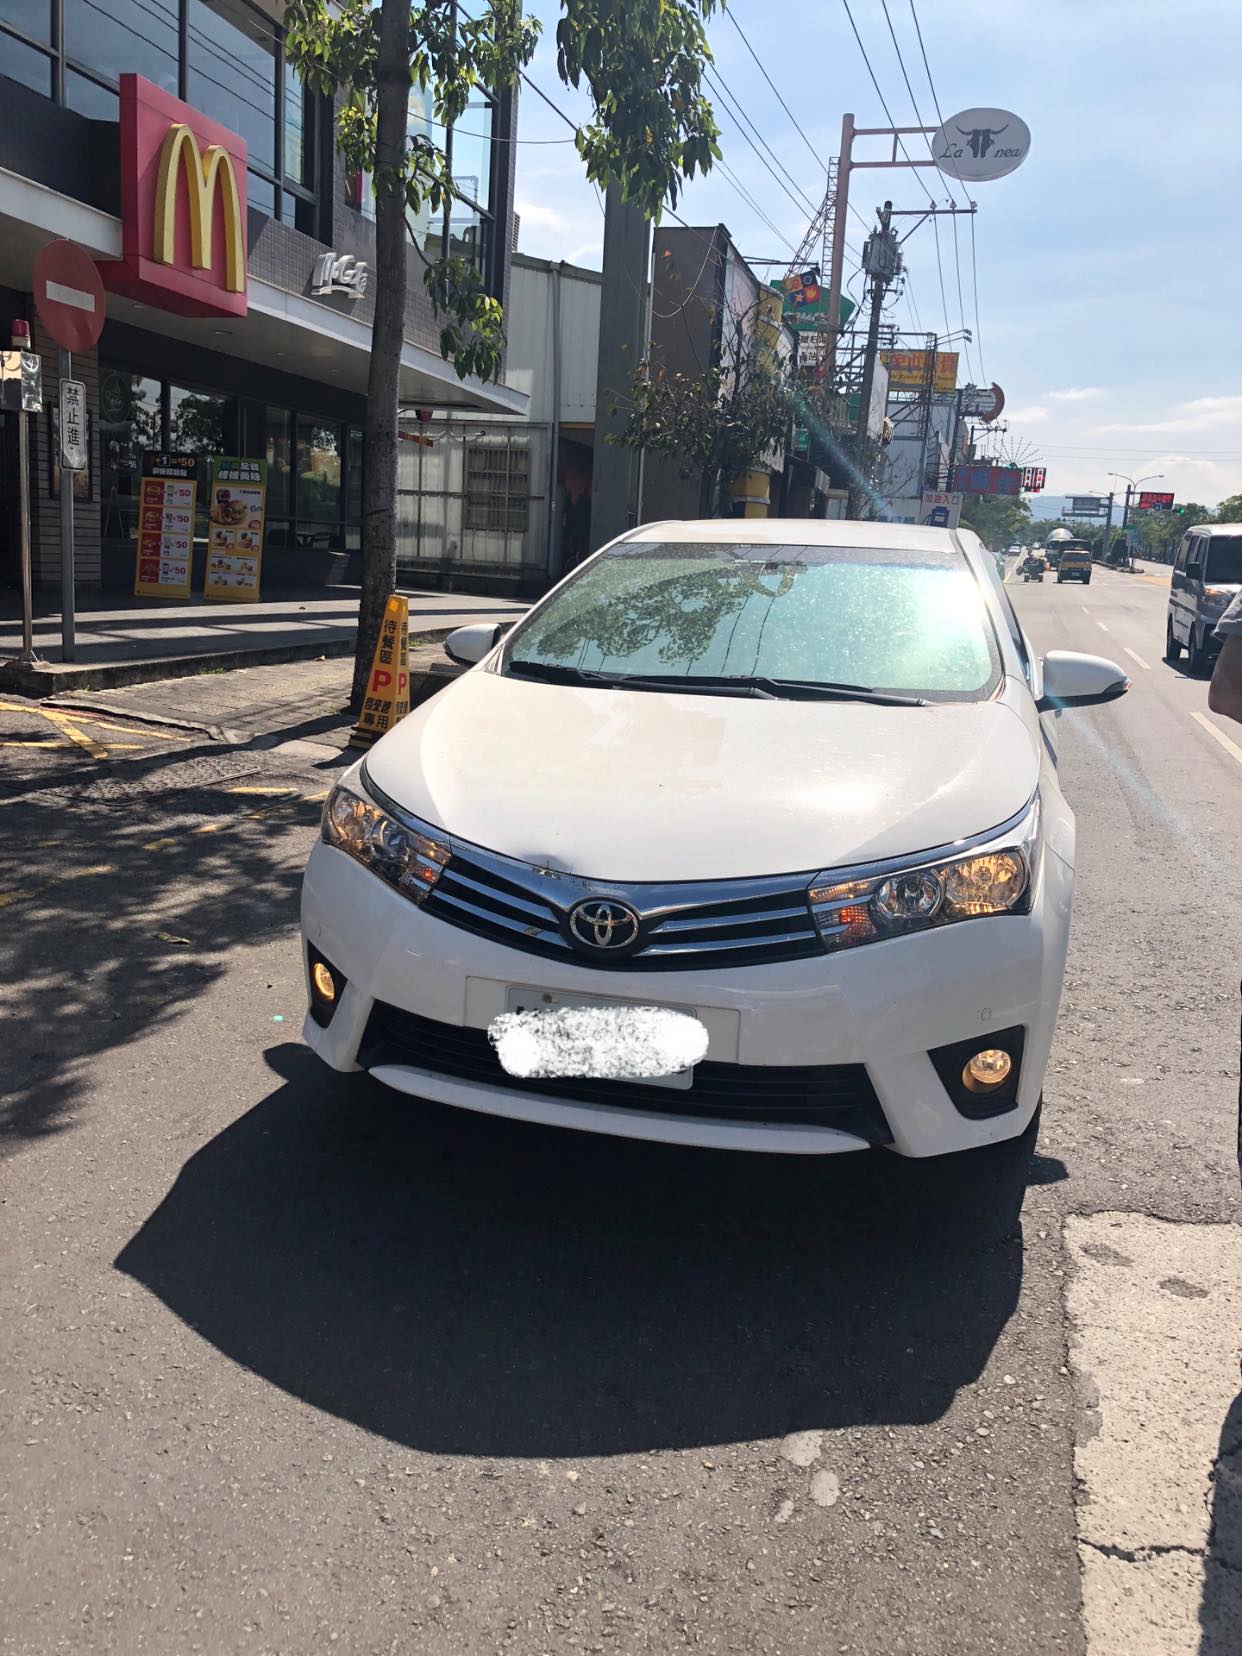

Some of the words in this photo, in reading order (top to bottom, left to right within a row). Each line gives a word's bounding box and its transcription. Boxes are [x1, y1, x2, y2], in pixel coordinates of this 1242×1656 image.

[938, 143, 963, 159] La
[993, 148, 1022, 158] new
[372, 669, 392, 692] P
[398, 672, 408, 695] P
